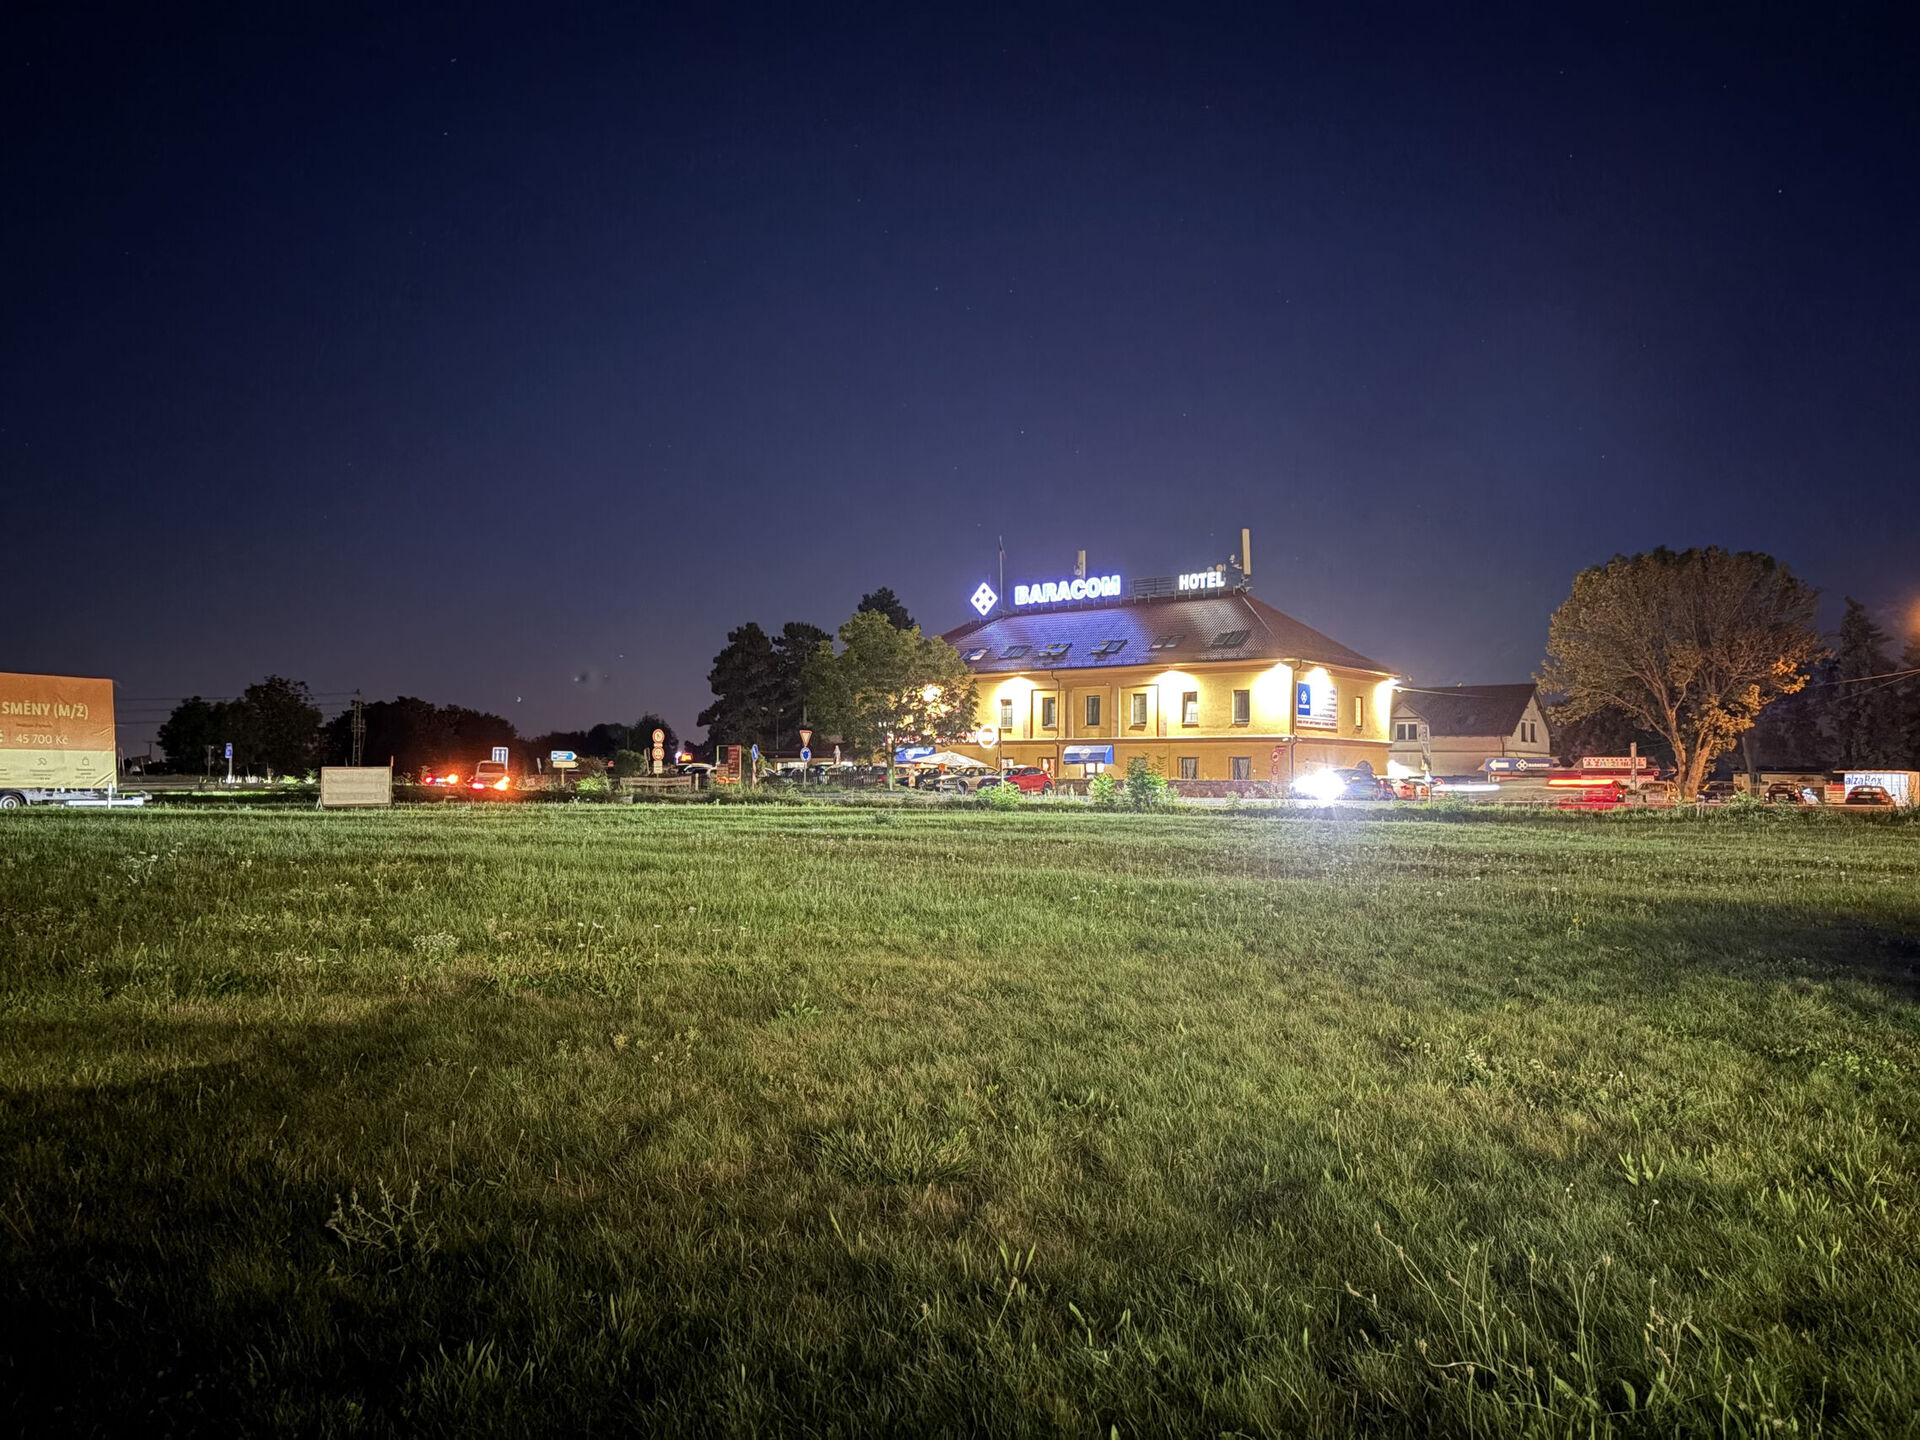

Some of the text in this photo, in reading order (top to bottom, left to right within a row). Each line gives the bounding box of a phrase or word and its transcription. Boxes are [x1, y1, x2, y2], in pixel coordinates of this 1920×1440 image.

[1014, 575, 1121, 605] BARACOM
[1178, 571, 1225, 591] HOTEL
[54, 703, 88, 719] (M/Ž)
[16, 734, 30, 744] 45
[32, 734, 52, 745] 700
